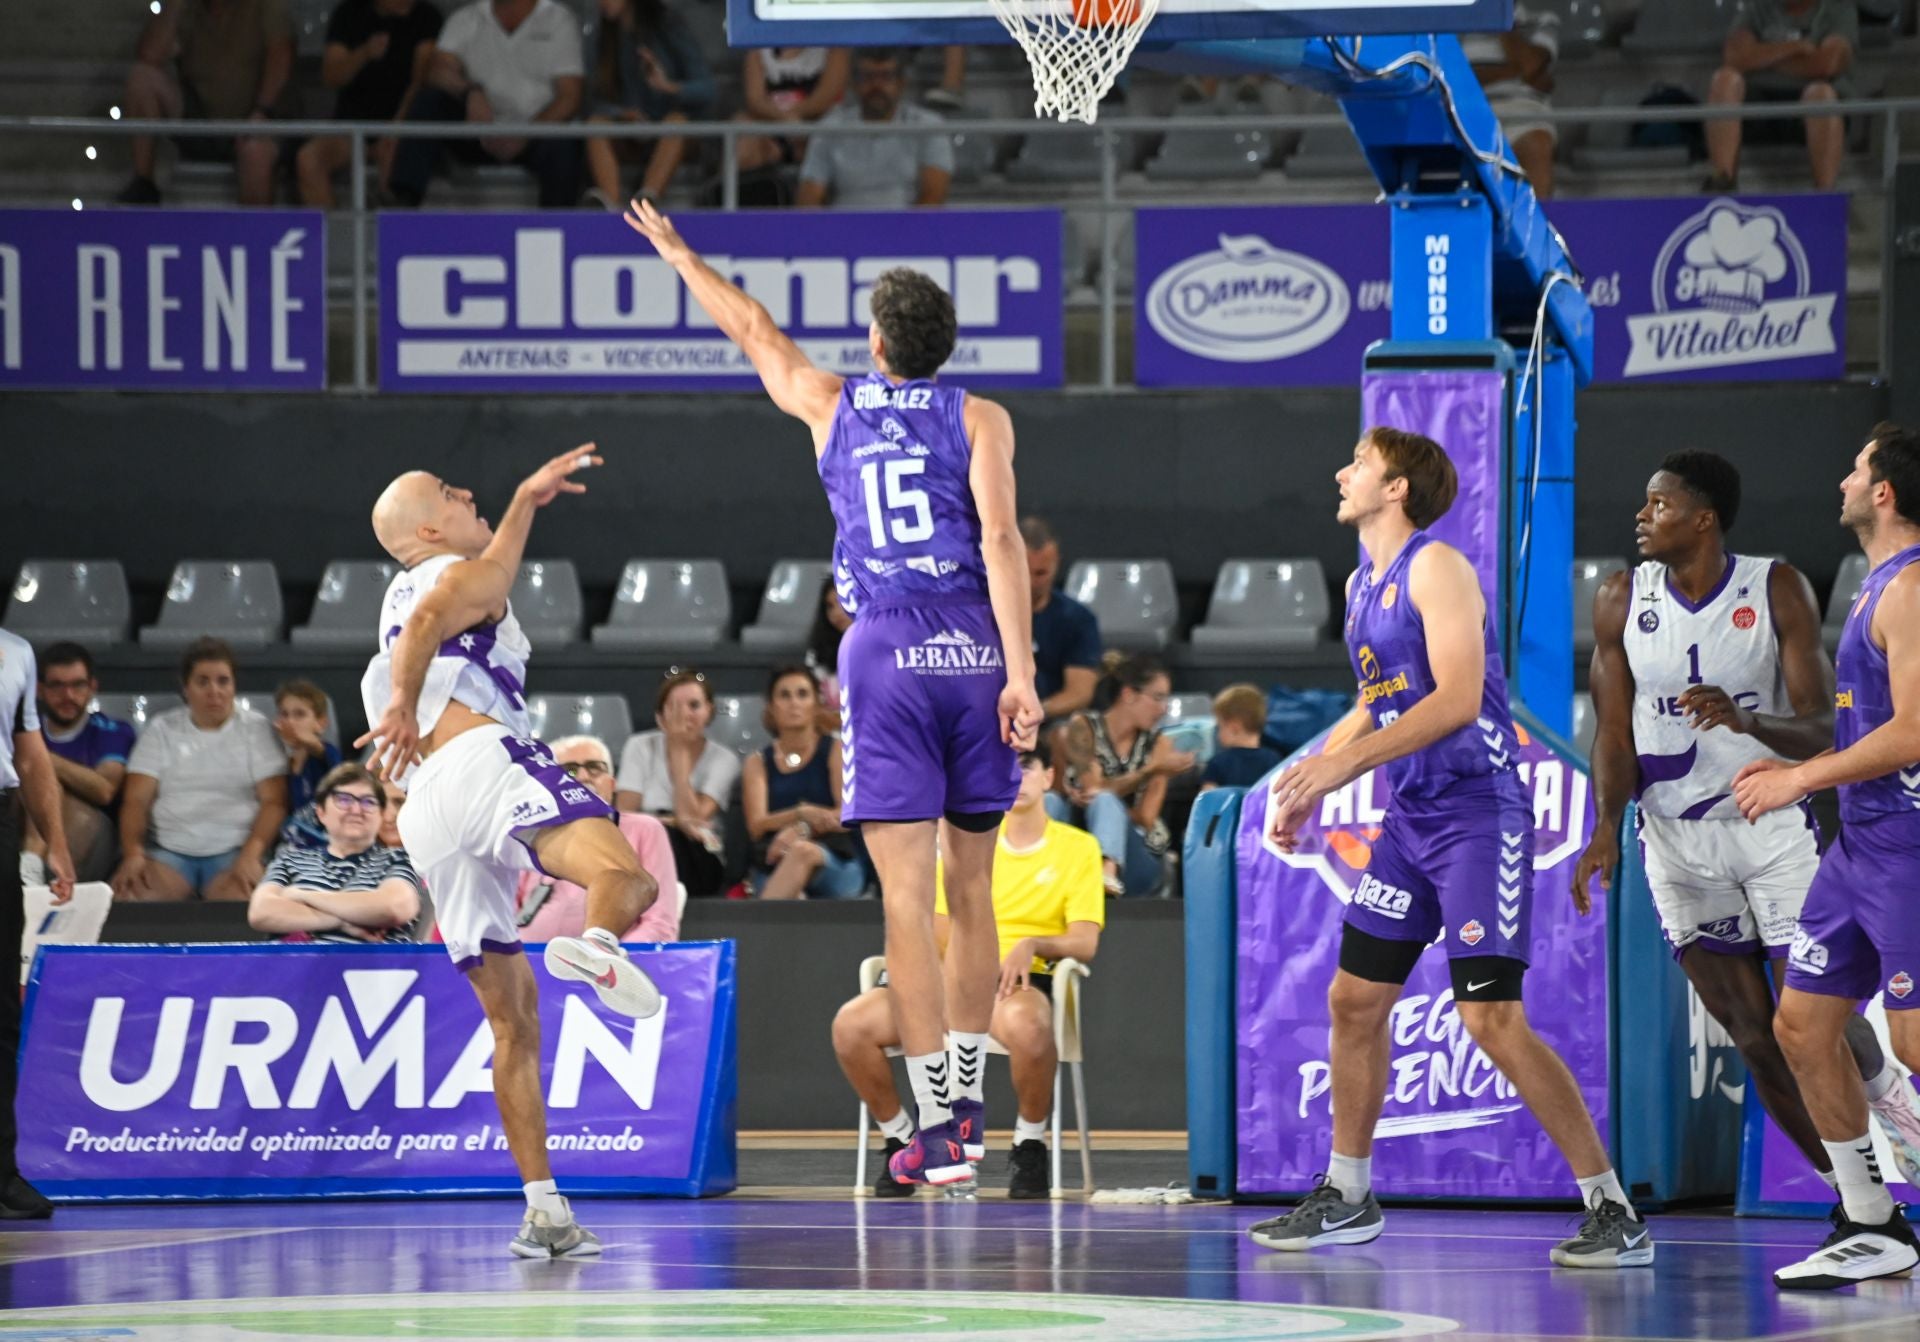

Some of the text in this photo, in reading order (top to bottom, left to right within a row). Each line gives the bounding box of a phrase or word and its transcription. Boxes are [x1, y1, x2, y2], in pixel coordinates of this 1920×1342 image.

[77, 227, 306, 372] RENÉ
[1424, 234, 1450, 335] MONDO
[1646, 303, 1817, 361] Vitalchef
[458, 348, 570, 368] ANTENAS
[602, 348, 750, 368] VIDEOVIGILA
[860, 458, 935, 549] 15
[894, 645, 1004, 669] LEBANZA
[1686, 643, 1703, 684] 1
[1362, 671, 1409, 704] gropal
[1354, 872, 1413, 914] gaza
[1789, 931, 1829, 969] aza
[80, 992, 668, 1112] URMAN
[65, 1125, 644, 1161] Productividad optimizada para el manizado
